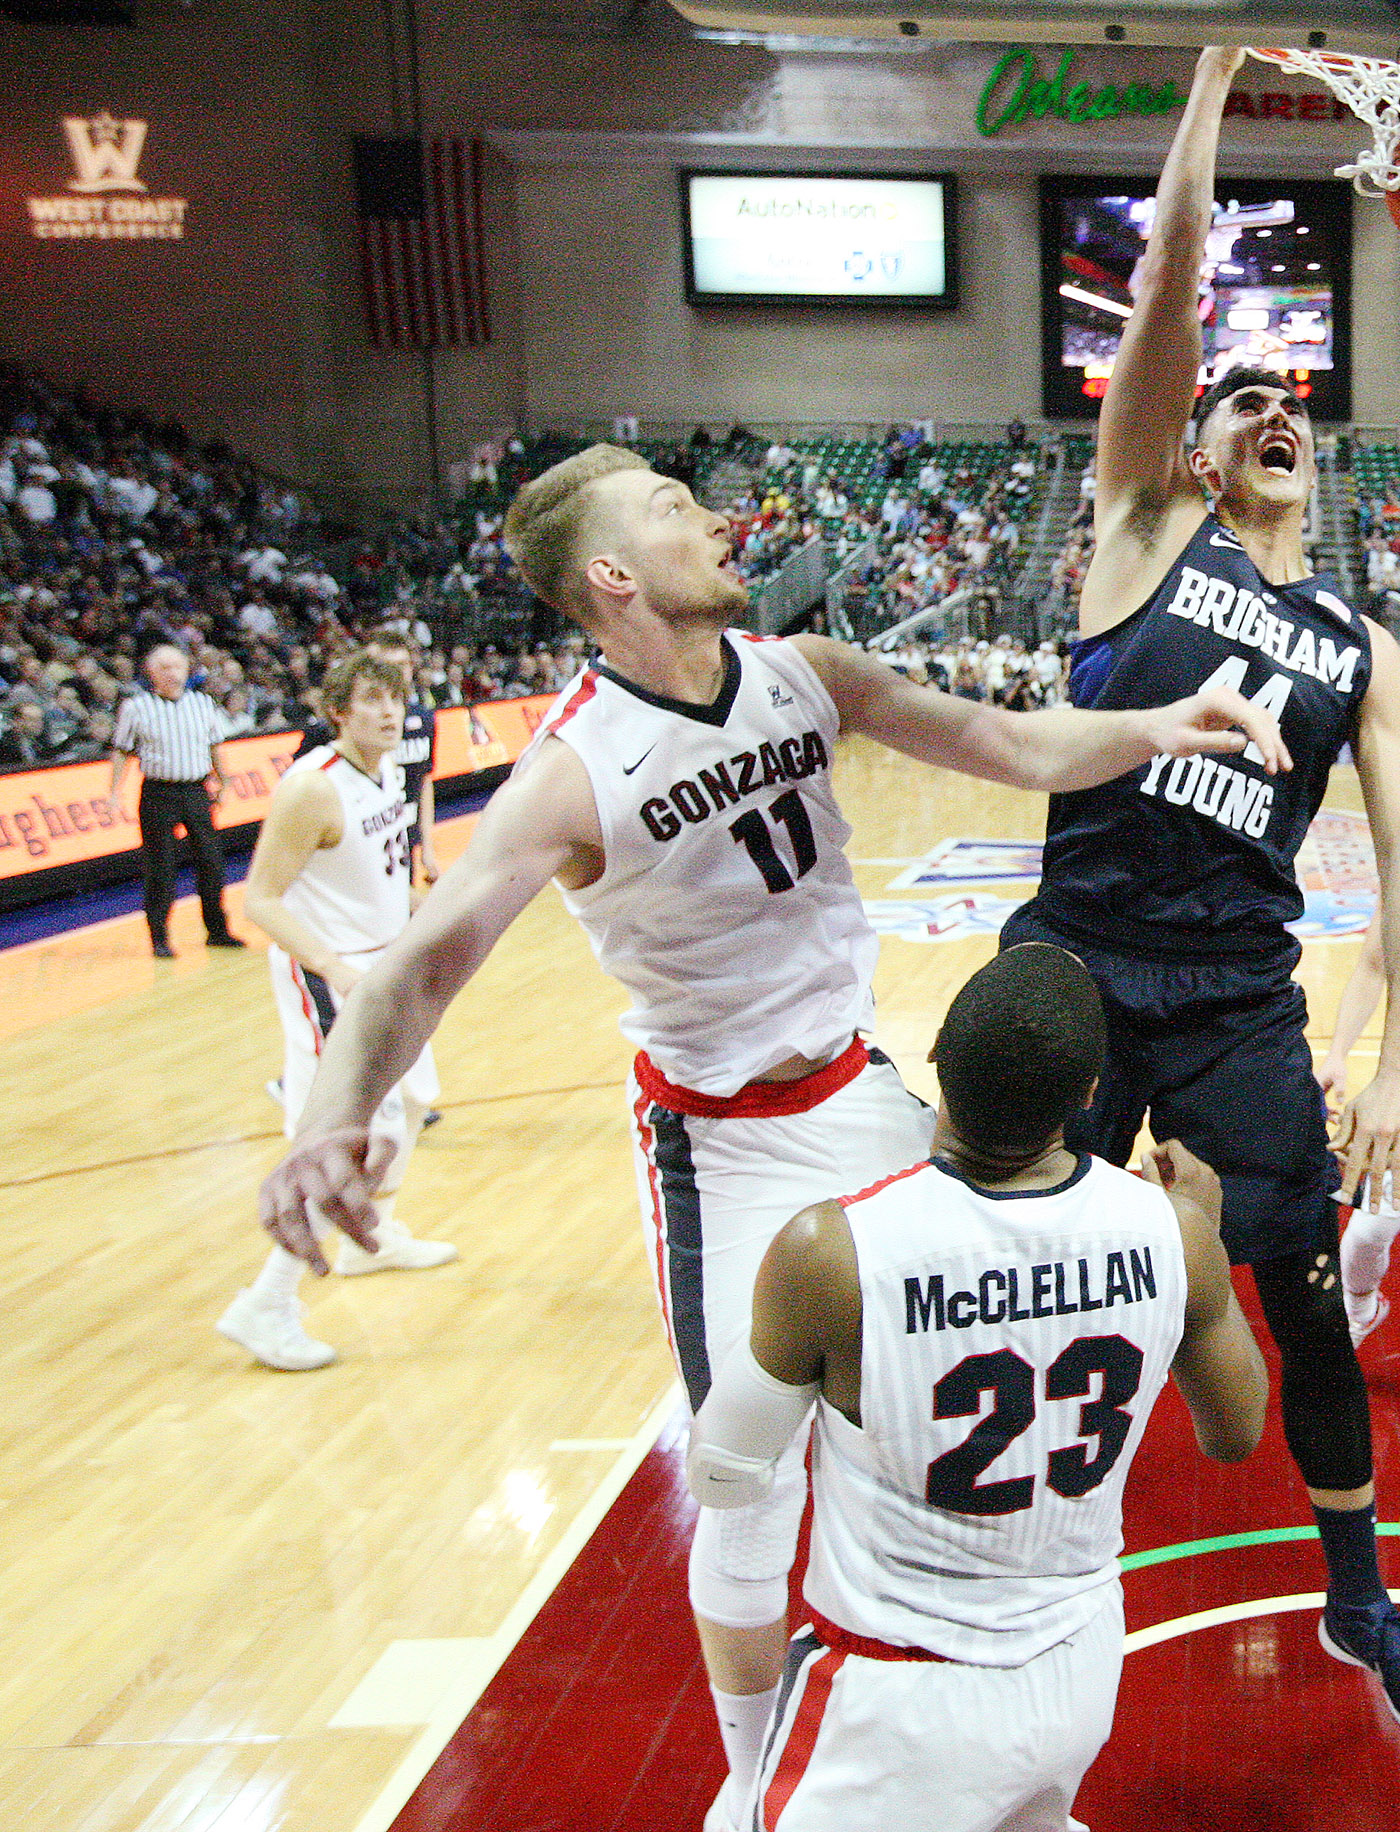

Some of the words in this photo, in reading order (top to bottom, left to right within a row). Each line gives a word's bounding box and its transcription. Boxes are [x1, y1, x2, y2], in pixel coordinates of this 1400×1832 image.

[737, 198, 876, 219] AutoNation
[1167, 566, 1361, 693] BRIGHAM
[640, 729, 828, 841] GONZAGA
[1140, 752, 1274, 839] YOUNG
[728, 788, 817, 894] 11
[904, 1246, 1157, 1334] McCLELLAN
[925, 1333, 1145, 1517] 23
